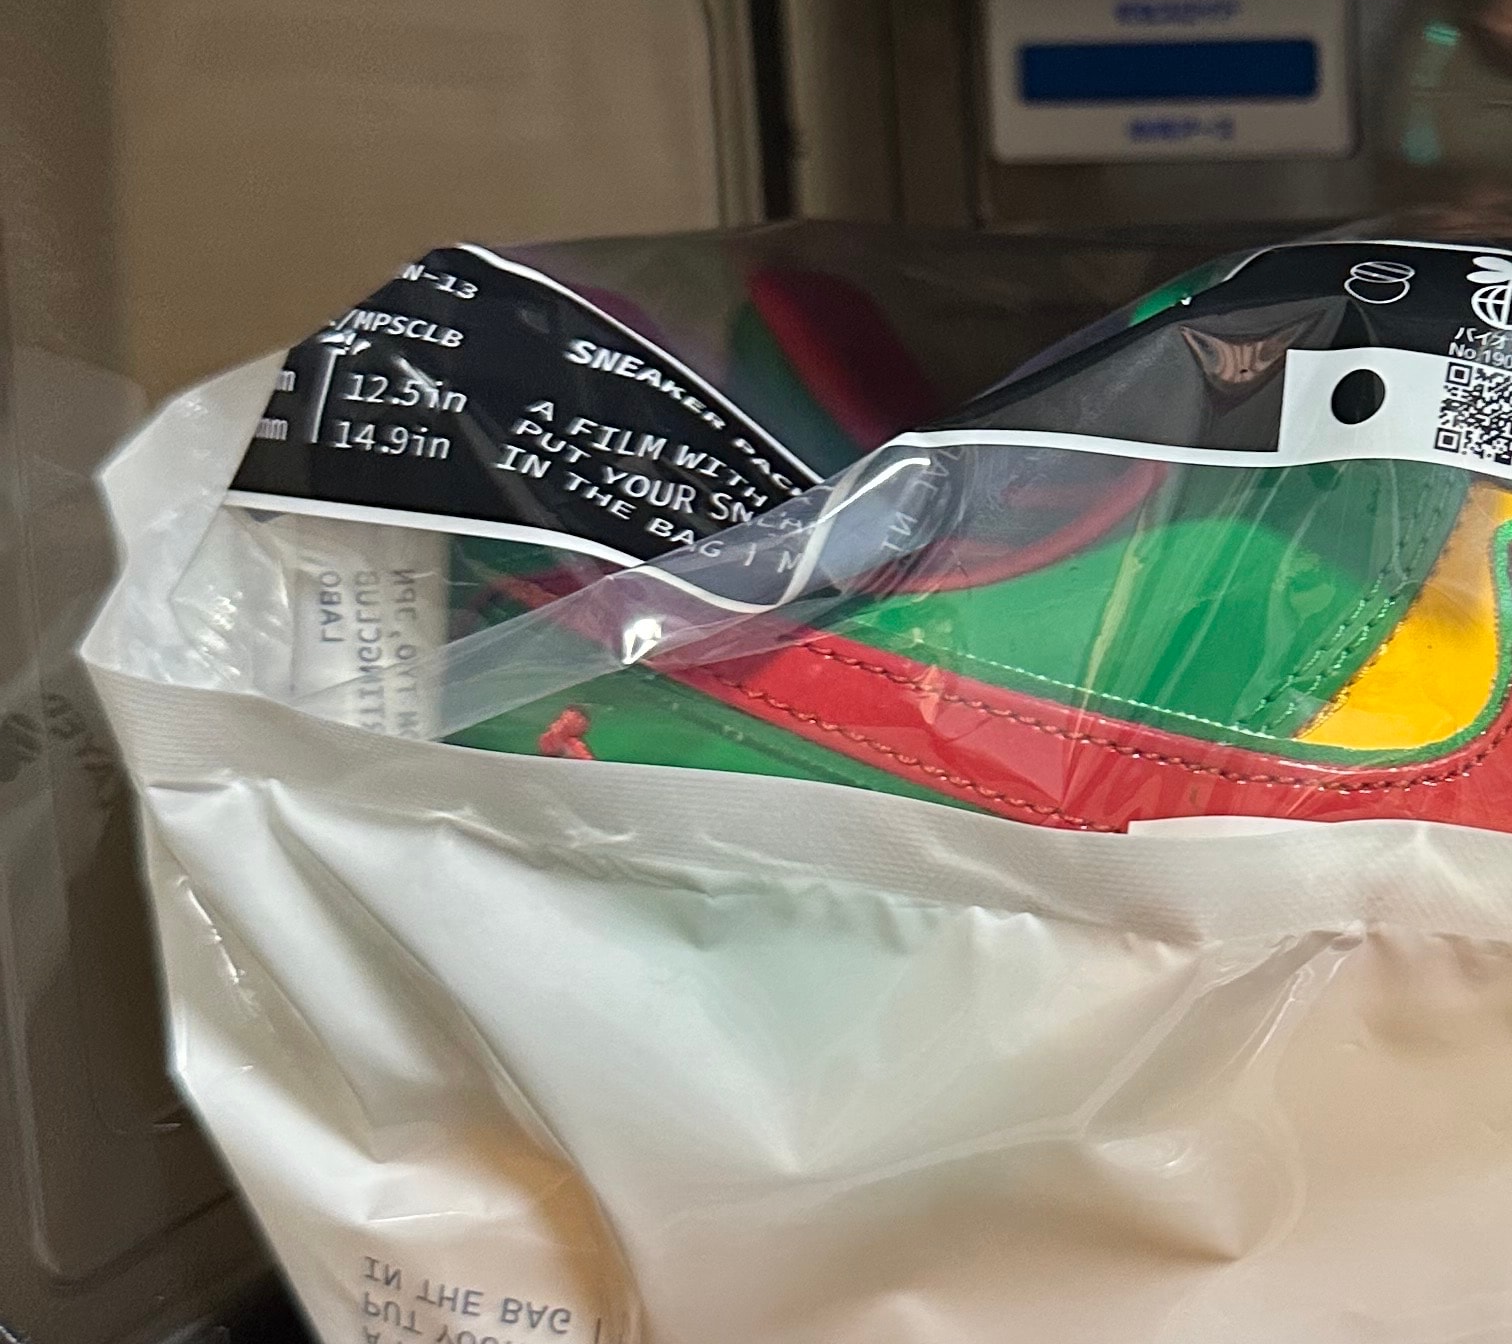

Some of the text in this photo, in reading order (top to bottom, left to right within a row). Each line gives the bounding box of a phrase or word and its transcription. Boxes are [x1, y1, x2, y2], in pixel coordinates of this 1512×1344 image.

[330, 309, 465, 348] /MPSCLB
[344, 373, 468, 413] 12.5in
[565, 338, 727, 431] SNEAKER
[332, 419, 452, 459] 14.9in
[513, 419, 592, 464] PUT
[602, 466, 697, 515] YOUR
[529, 400, 768, 507] A FILM WITH
[496, 443, 551, 479] IN
[564, 471, 637, 521] THE
[645, 516, 724, 557] BAG
